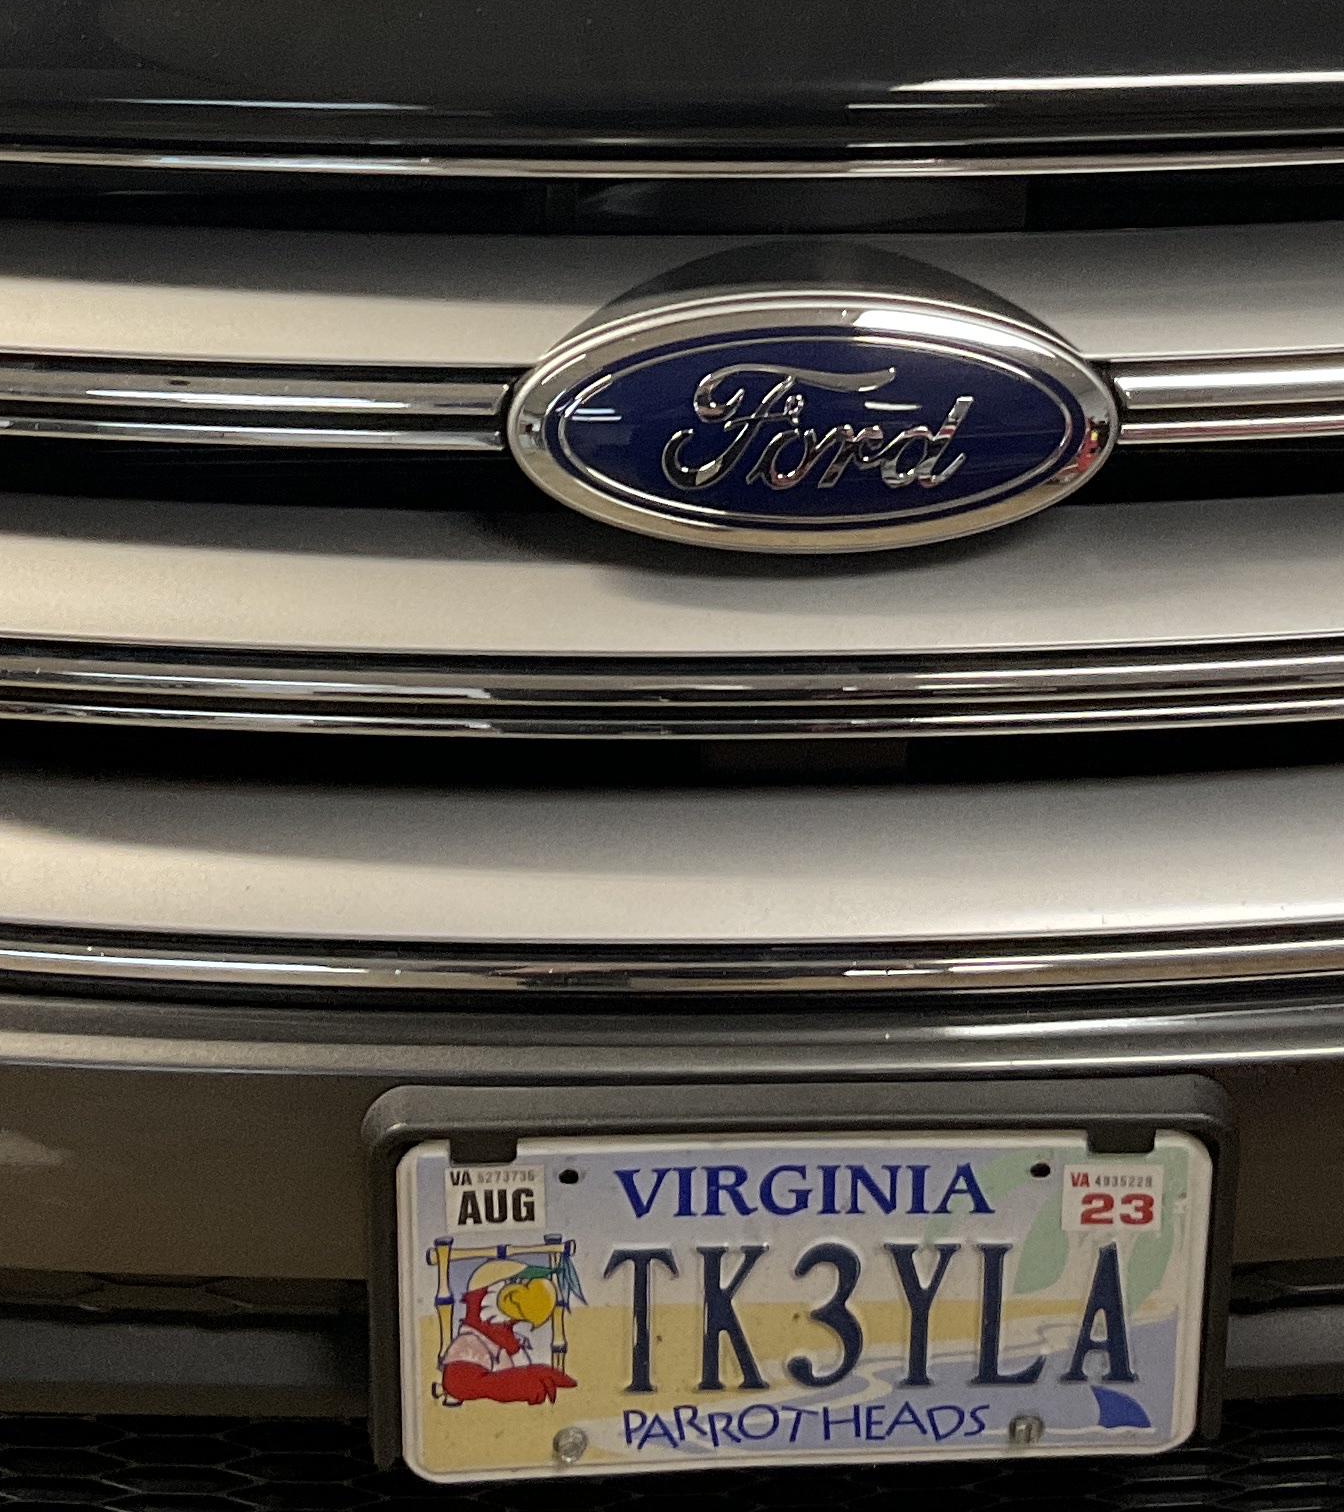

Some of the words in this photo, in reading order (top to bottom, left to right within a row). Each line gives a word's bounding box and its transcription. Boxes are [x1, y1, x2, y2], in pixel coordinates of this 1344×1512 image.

[662, 362, 972, 489] Ford
[449, 1170, 472, 1186] VA
[613, 1163, 995, 1219] VIRGINIA
[1070, 1172, 1091, 1188] VA
[458, 1188, 535, 1225] AUG
[1080, 1192, 1155, 1225] 23
[602, 1241, 1139, 1394] TK3YLA
